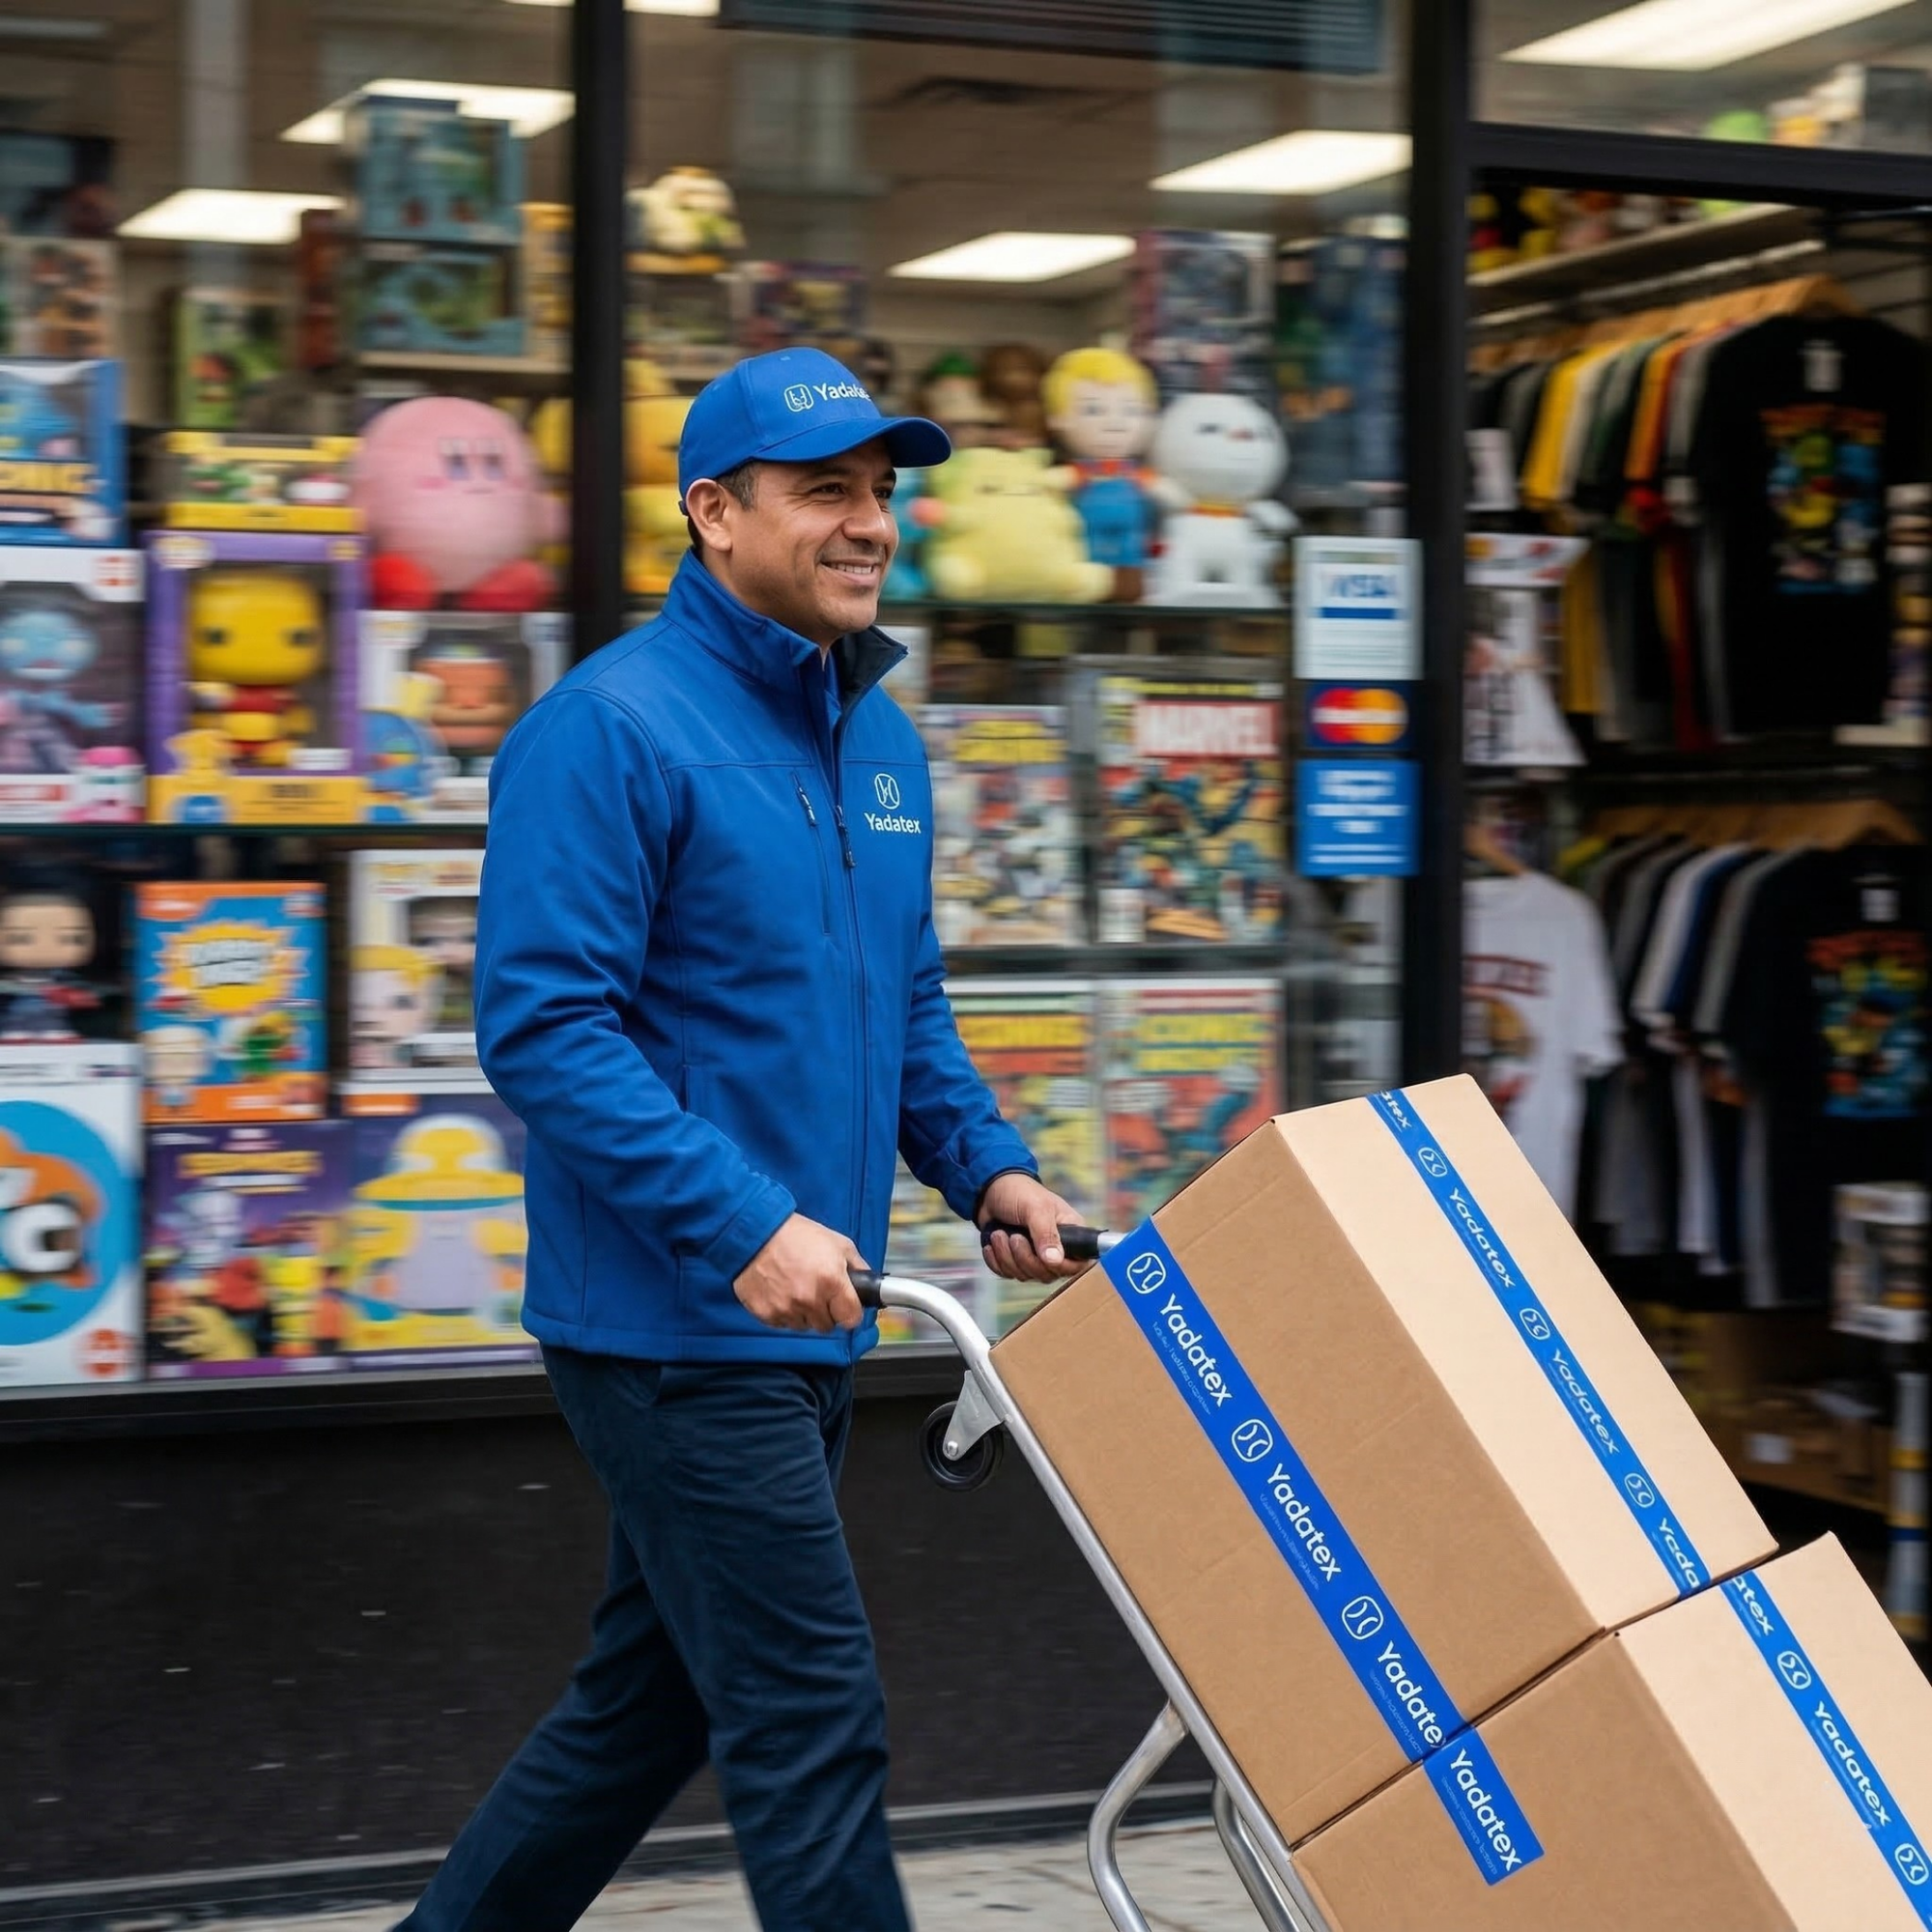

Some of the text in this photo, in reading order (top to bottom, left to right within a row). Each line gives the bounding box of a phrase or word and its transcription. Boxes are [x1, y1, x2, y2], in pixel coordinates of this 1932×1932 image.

[812, 381, 871, 401] Yadate
[864, 812, 922, 834] Yadatex
[1380, 1090, 1412, 1128] atex
[1159, 1293, 1233, 1407] Yadatex
[1552, 1349, 1620, 1454] Yadatex
[1266, 1463, 1342, 1582] Yadatex
[1659, 1518, 1700, 1588] Yada
[1732, 1576, 1775, 1635] atex
[1377, 1639, 1446, 1748] Yadate
[1450, 1747, 1522, 1872] Yadatex
[1814, 1700, 1891, 1827] Yadatex
